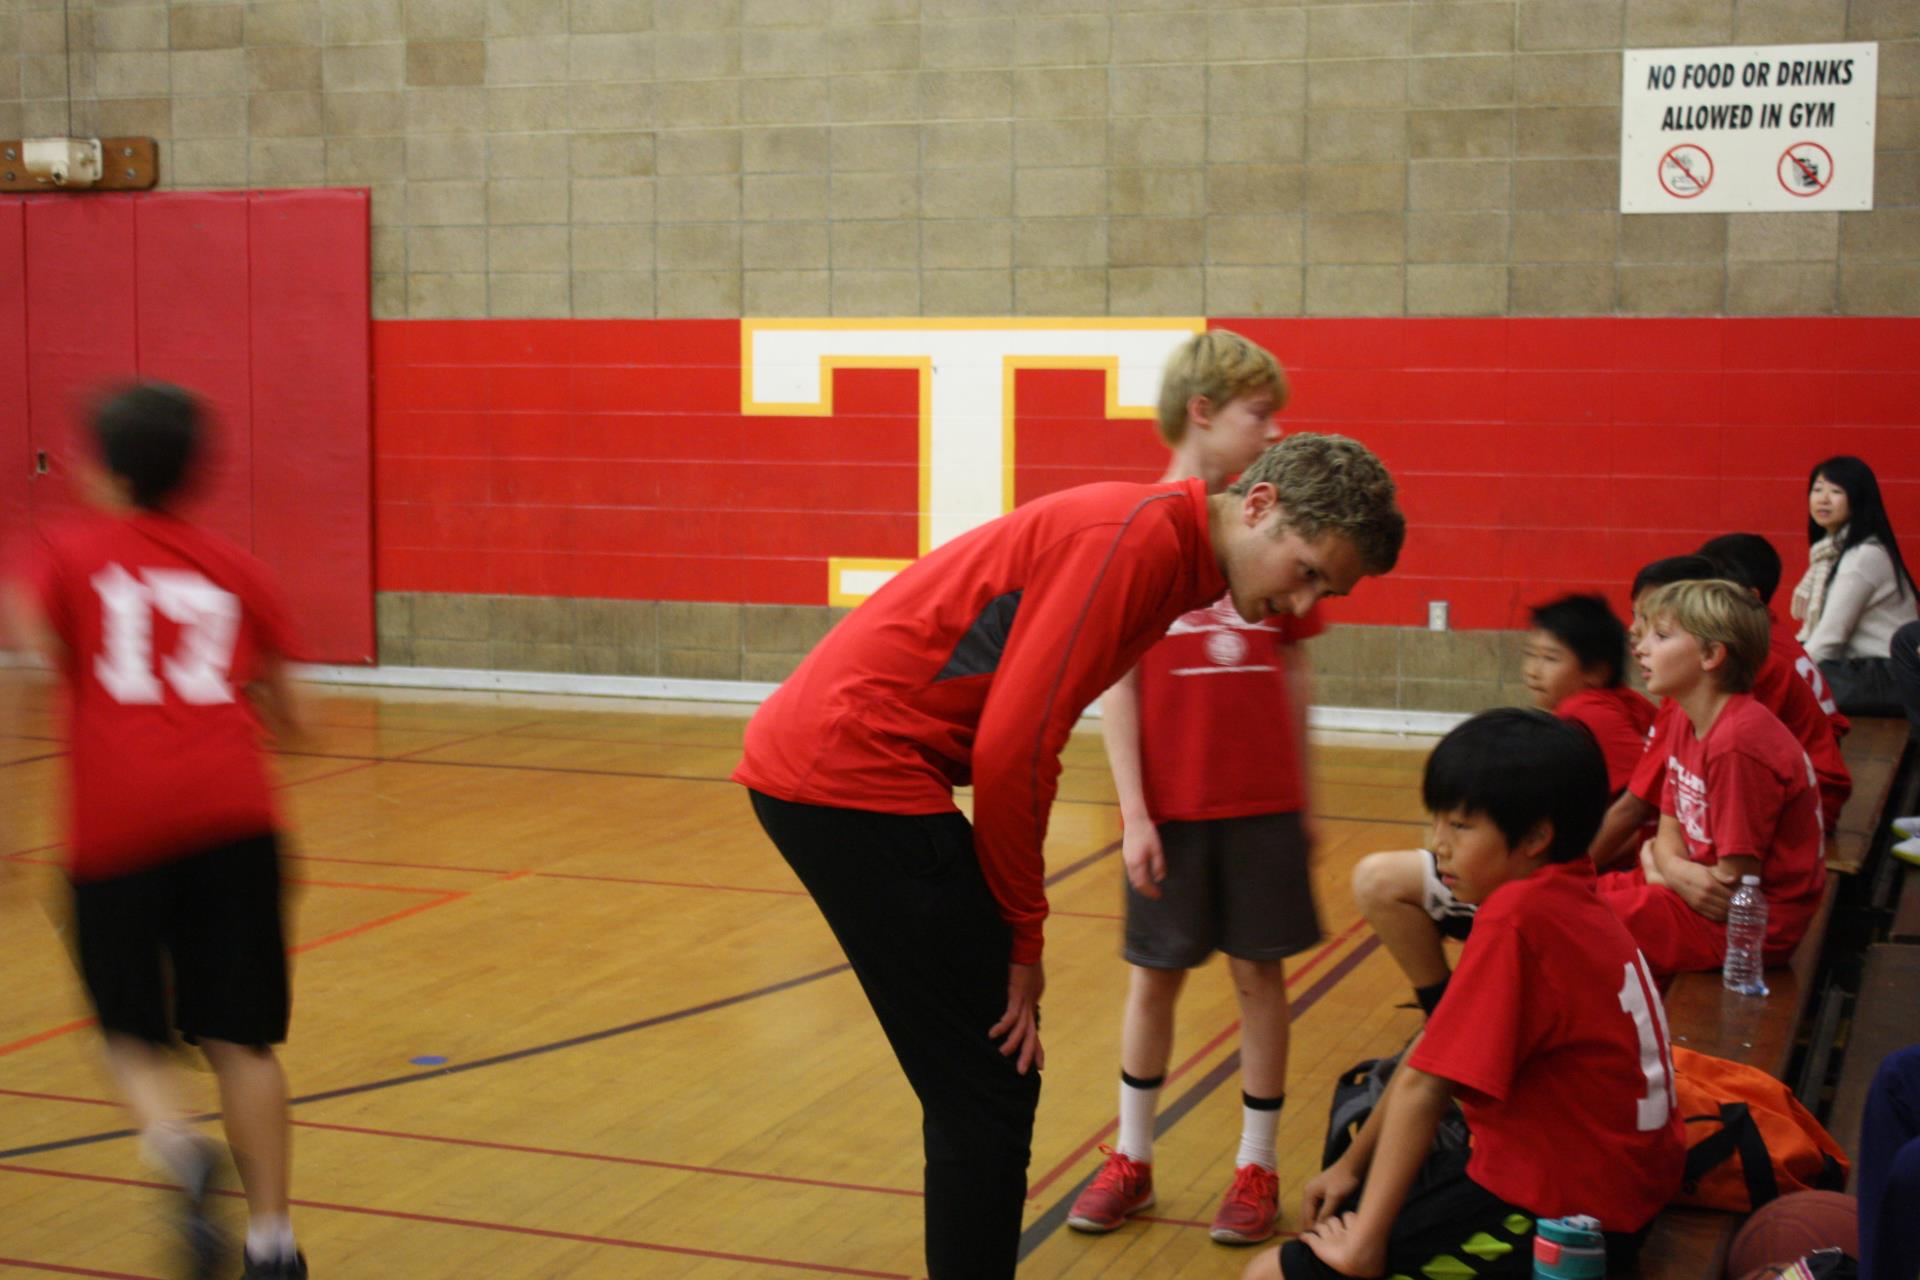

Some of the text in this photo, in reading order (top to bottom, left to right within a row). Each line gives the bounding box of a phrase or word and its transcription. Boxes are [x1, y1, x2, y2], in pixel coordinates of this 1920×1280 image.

[1647, 59, 1854, 90] NO FOOD OR DRINKS
[1661, 102, 1835, 131] ALLOWED IN GYM
[740, 316, 1206, 608] T
